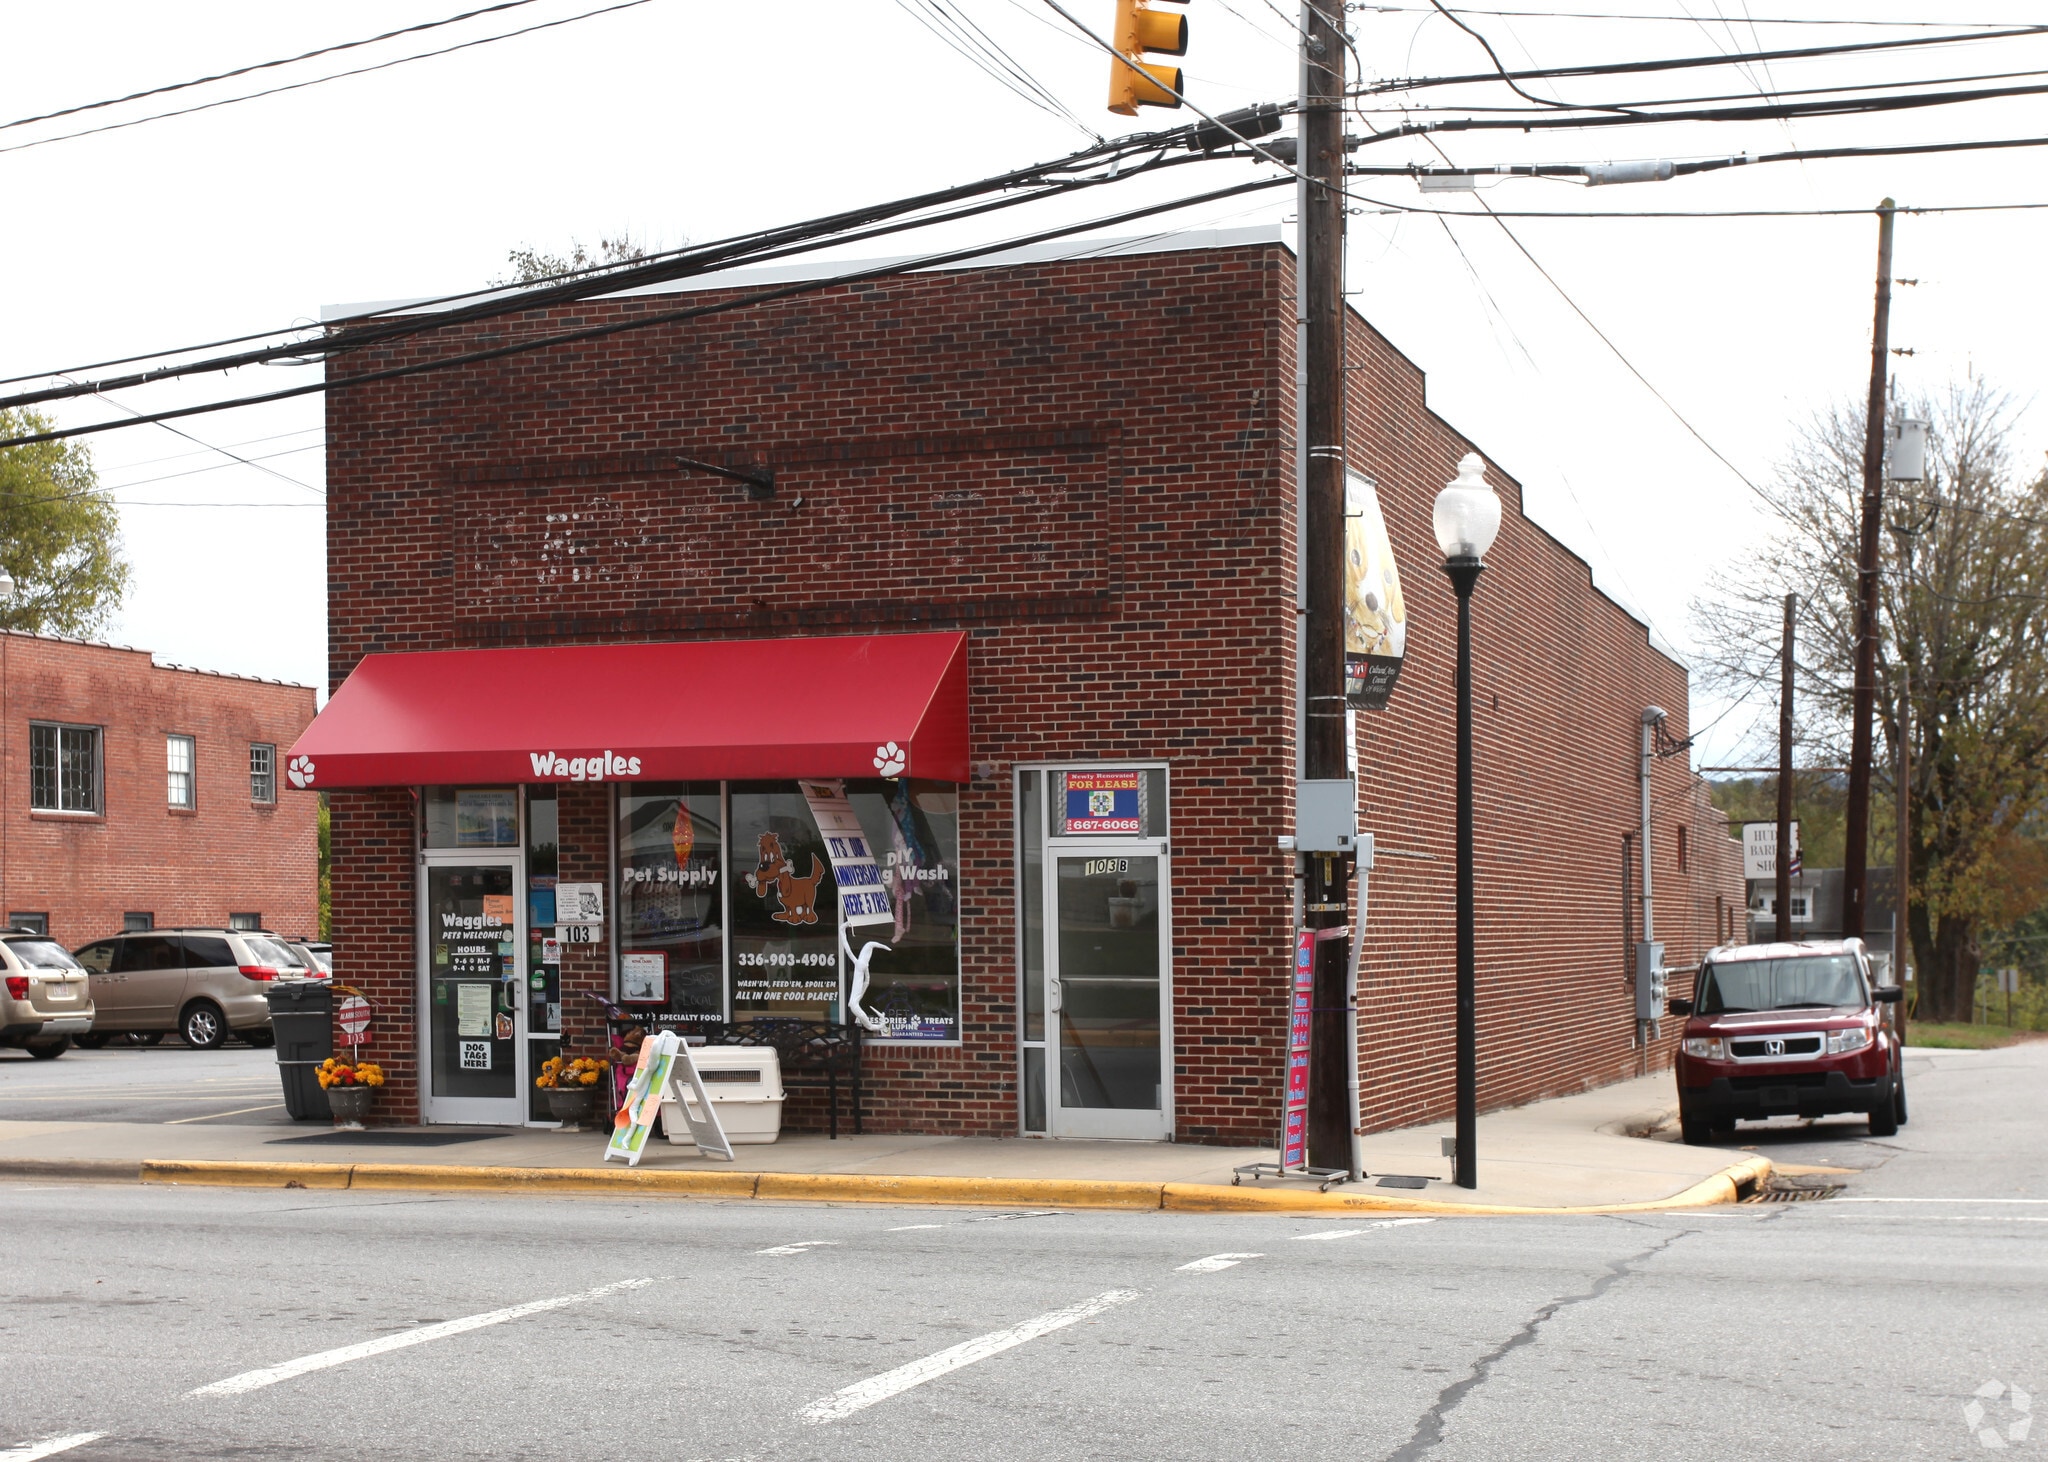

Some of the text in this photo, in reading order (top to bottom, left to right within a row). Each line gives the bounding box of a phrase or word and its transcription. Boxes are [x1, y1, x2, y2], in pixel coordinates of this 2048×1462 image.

[529, 750, 641, 781] Waggles
[1069, 780, 1137, 789] FOR LEASE
[1073, 820, 1139, 830] 667-6066
[829, 837, 867, 858] IT'S OUR
[887, 847, 913, 867] DIY
[900, 864, 949, 881] Wash
[1087, 860, 1127, 875] 103B
[623, 866, 718, 886] Pet Supply
[833, 864, 884, 887] ANNIVERSARY
[842, 891, 890, 916] HERE 5 YRS!
[442, 912, 503, 930] Waggles
[442, 931, 503, 940] PETS WELCOME!
[565, 926, 590, 942] 103
[457, 945, 486, 953] HOURS
[738, 953, 836, 966] 336-903-4906
[737, 980, 837, 988] WASH'EM, FEED'EM, SPOIL'EM
[735, 991, 838, 1001] ALL IN ONE COOL PLACE!
[924, 1017, 954, 1025] TREATS
[347, 1033, 365, 1045] 103
[466, 1043, 484, 1051] DOG
[464, 1051, 487, 1060] TAGS
[464, 1060, 487, 1068] HERE
